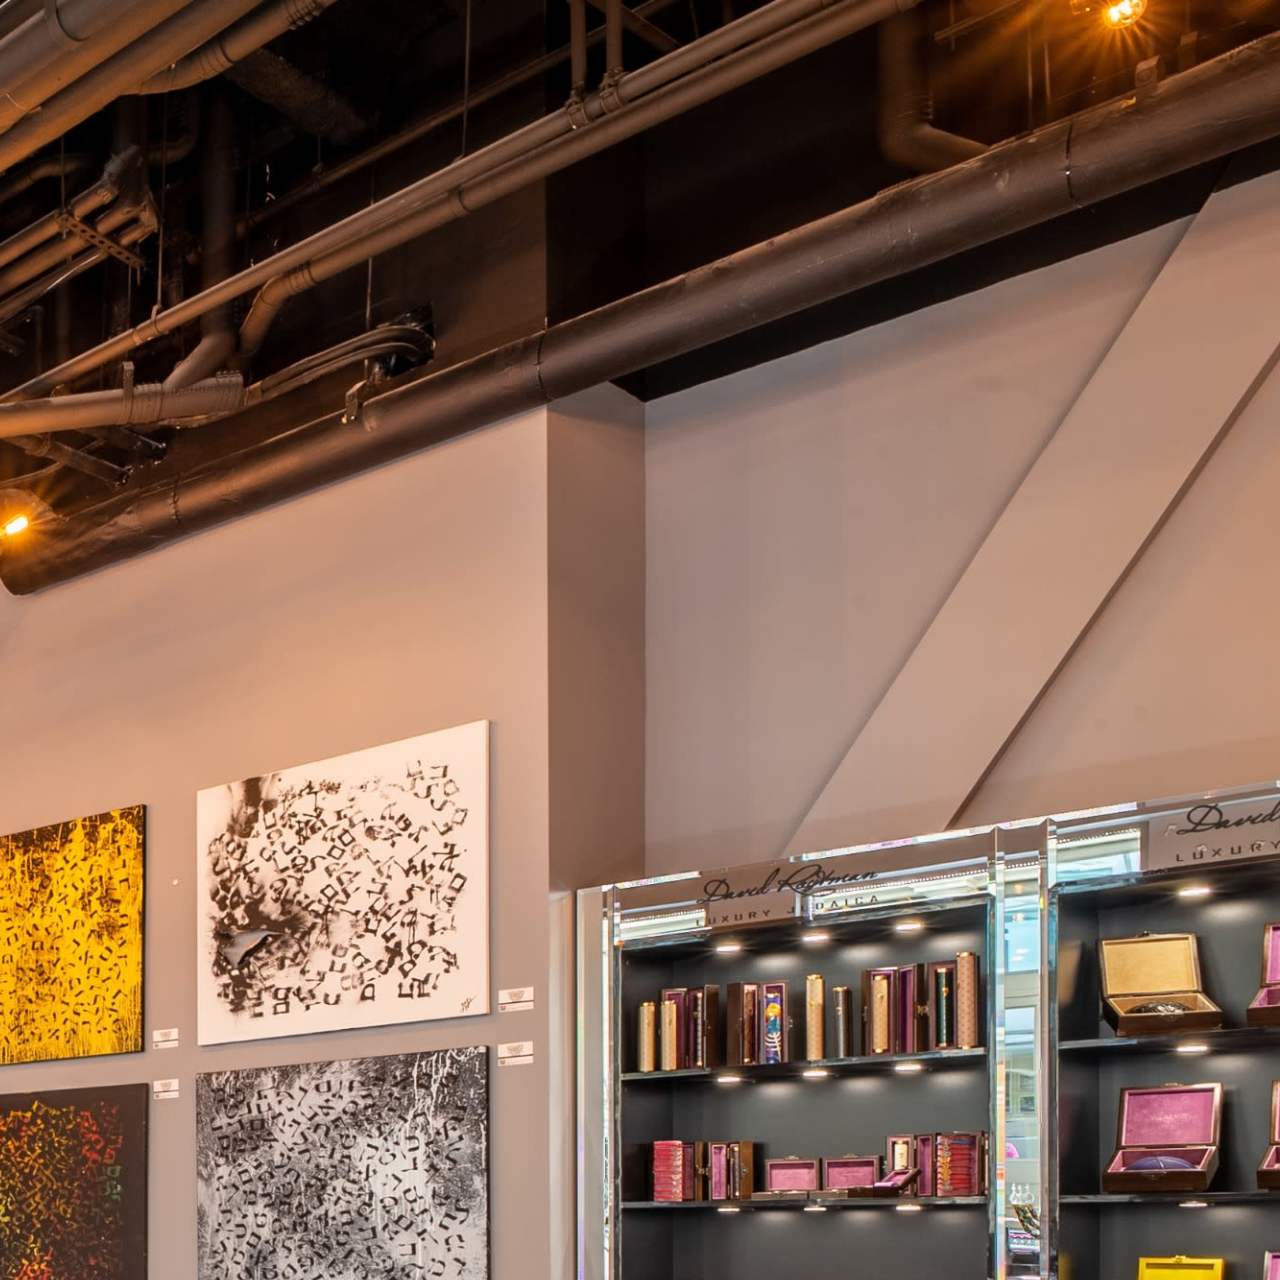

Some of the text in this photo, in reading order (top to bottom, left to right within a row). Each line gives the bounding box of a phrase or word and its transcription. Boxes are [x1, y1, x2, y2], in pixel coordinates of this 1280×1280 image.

[1175, 840, 1280, 862] LUXURY
[697, 868, 780, 903] David
[695, 909, 770, 926] LUXURY
